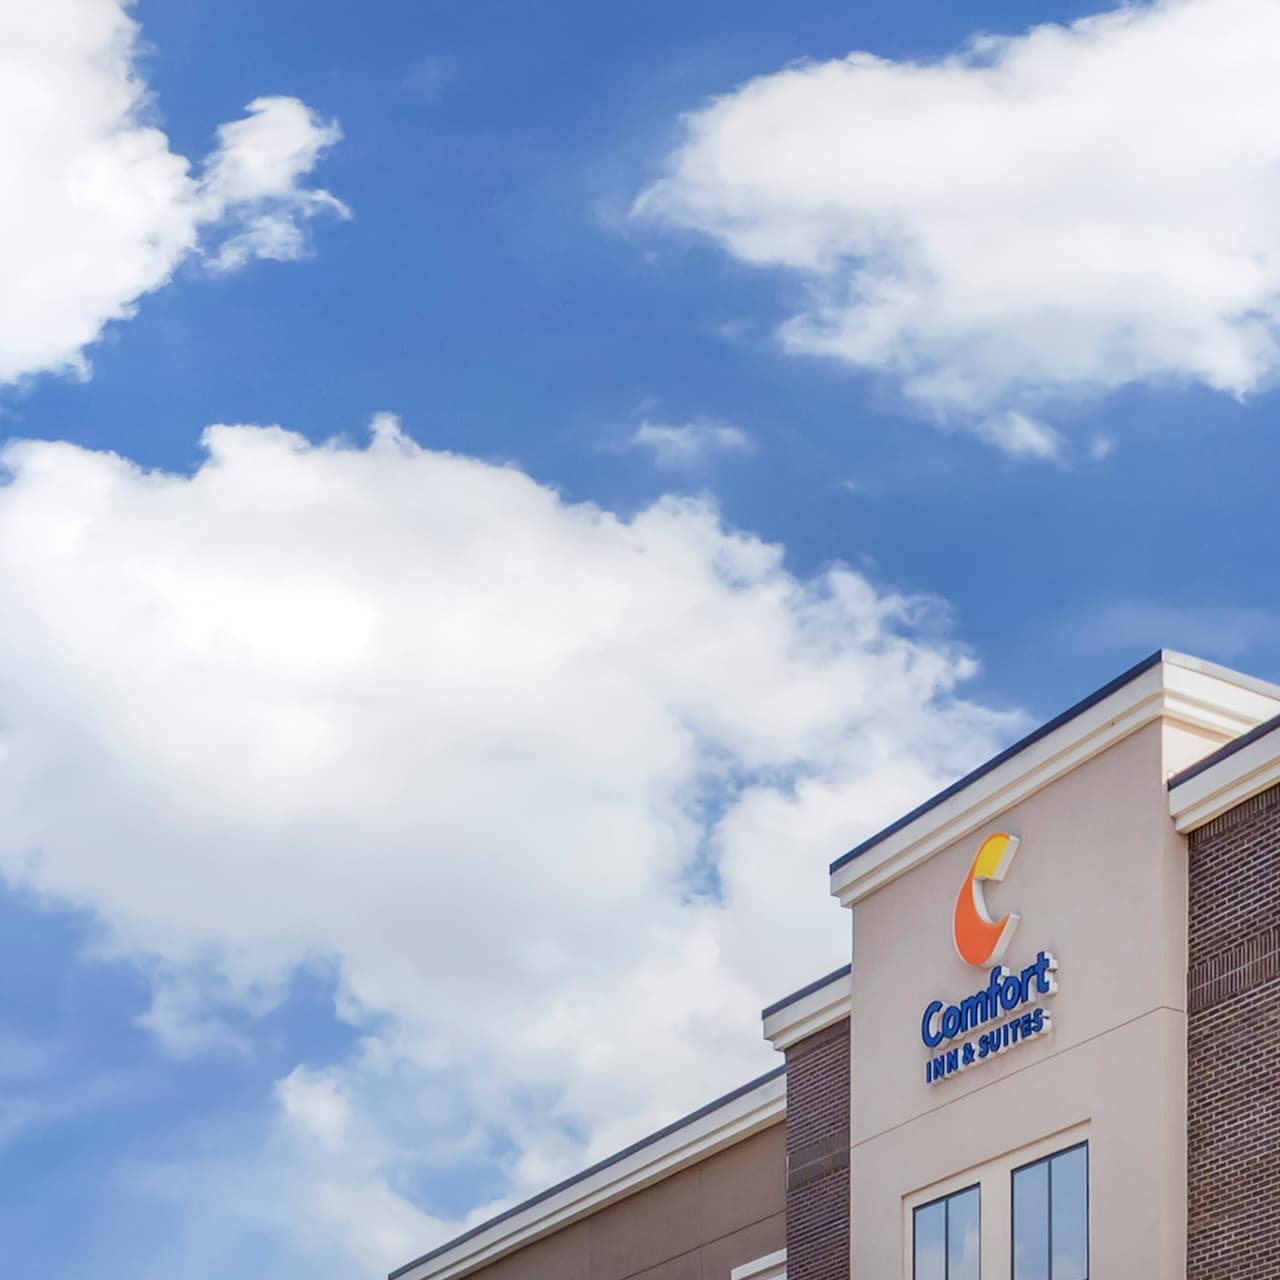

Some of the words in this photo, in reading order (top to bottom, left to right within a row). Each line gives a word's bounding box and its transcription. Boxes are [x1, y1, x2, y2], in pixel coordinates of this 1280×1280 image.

[921, 950, 1052, 1048] Comfort
[925, 1047, 960, 1084] INN
[962, 1042, 976, 1066] &
[978, 1007, 1045, 1058] SUITES
